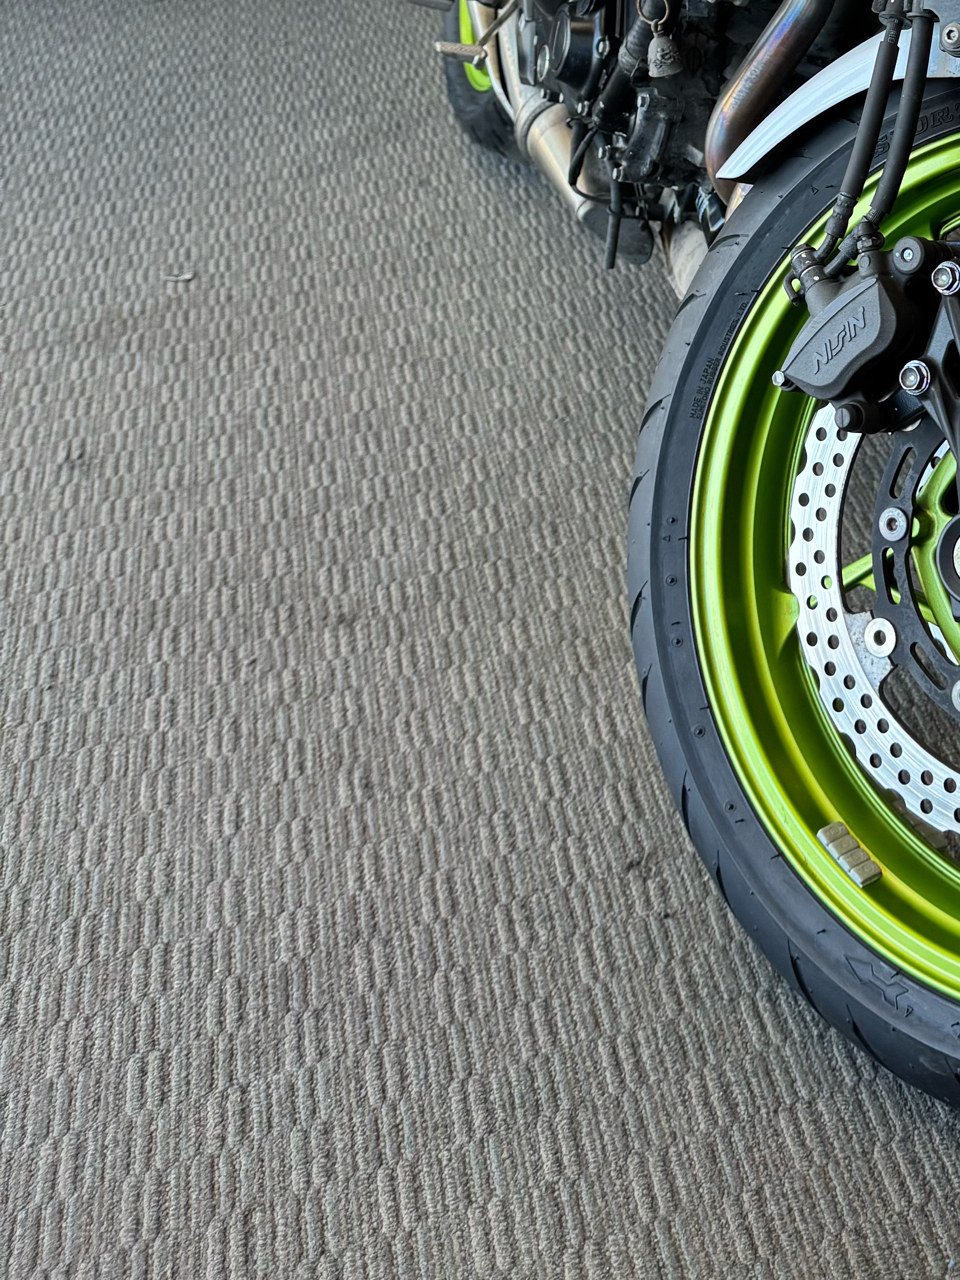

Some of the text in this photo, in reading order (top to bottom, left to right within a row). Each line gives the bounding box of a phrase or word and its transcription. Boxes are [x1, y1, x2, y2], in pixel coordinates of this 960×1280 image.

[689, 357, 716, 419] MADE IN JAPAN
[696, 385, 711, 420] SUMITOMO
[706, 357, 721, 386] RUBBER
